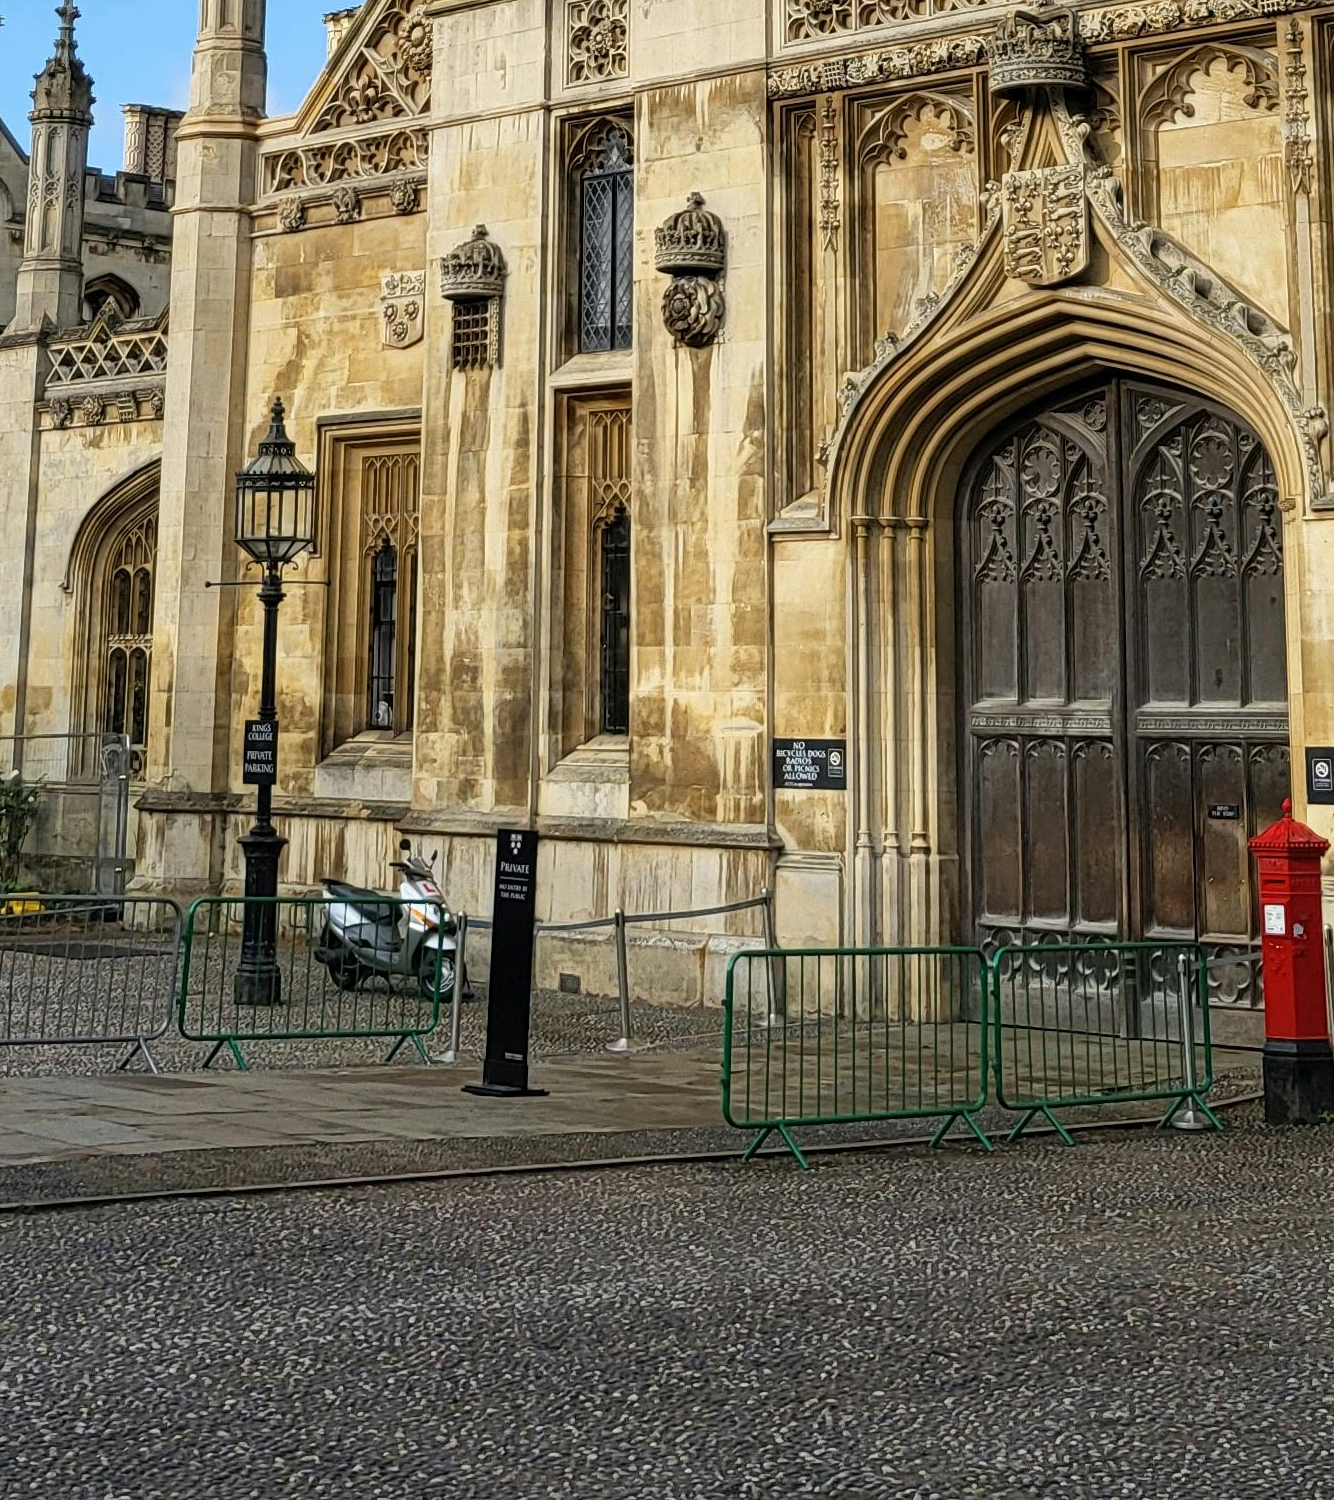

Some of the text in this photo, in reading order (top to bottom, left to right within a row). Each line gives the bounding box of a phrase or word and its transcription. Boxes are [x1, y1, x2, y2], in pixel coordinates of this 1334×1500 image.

[252, 723, 272, 732] KING'S
[248, 732, 273, 741] COLLEGE
[793, 741, 805, 750] NO
[247, 750, 272, 760] PRIVATE
[807, 750, 826, 758] DOGS
[786, 757, 812, 765] RADIOS
[245, 762, 274, 773] PARKING
[794, 765, 820, 773] PICNICS
[784, 772, 818, 781] ALLOWED
[500, 861, 529, 874] PRIVATE
[422, 883, 436, 893] L
